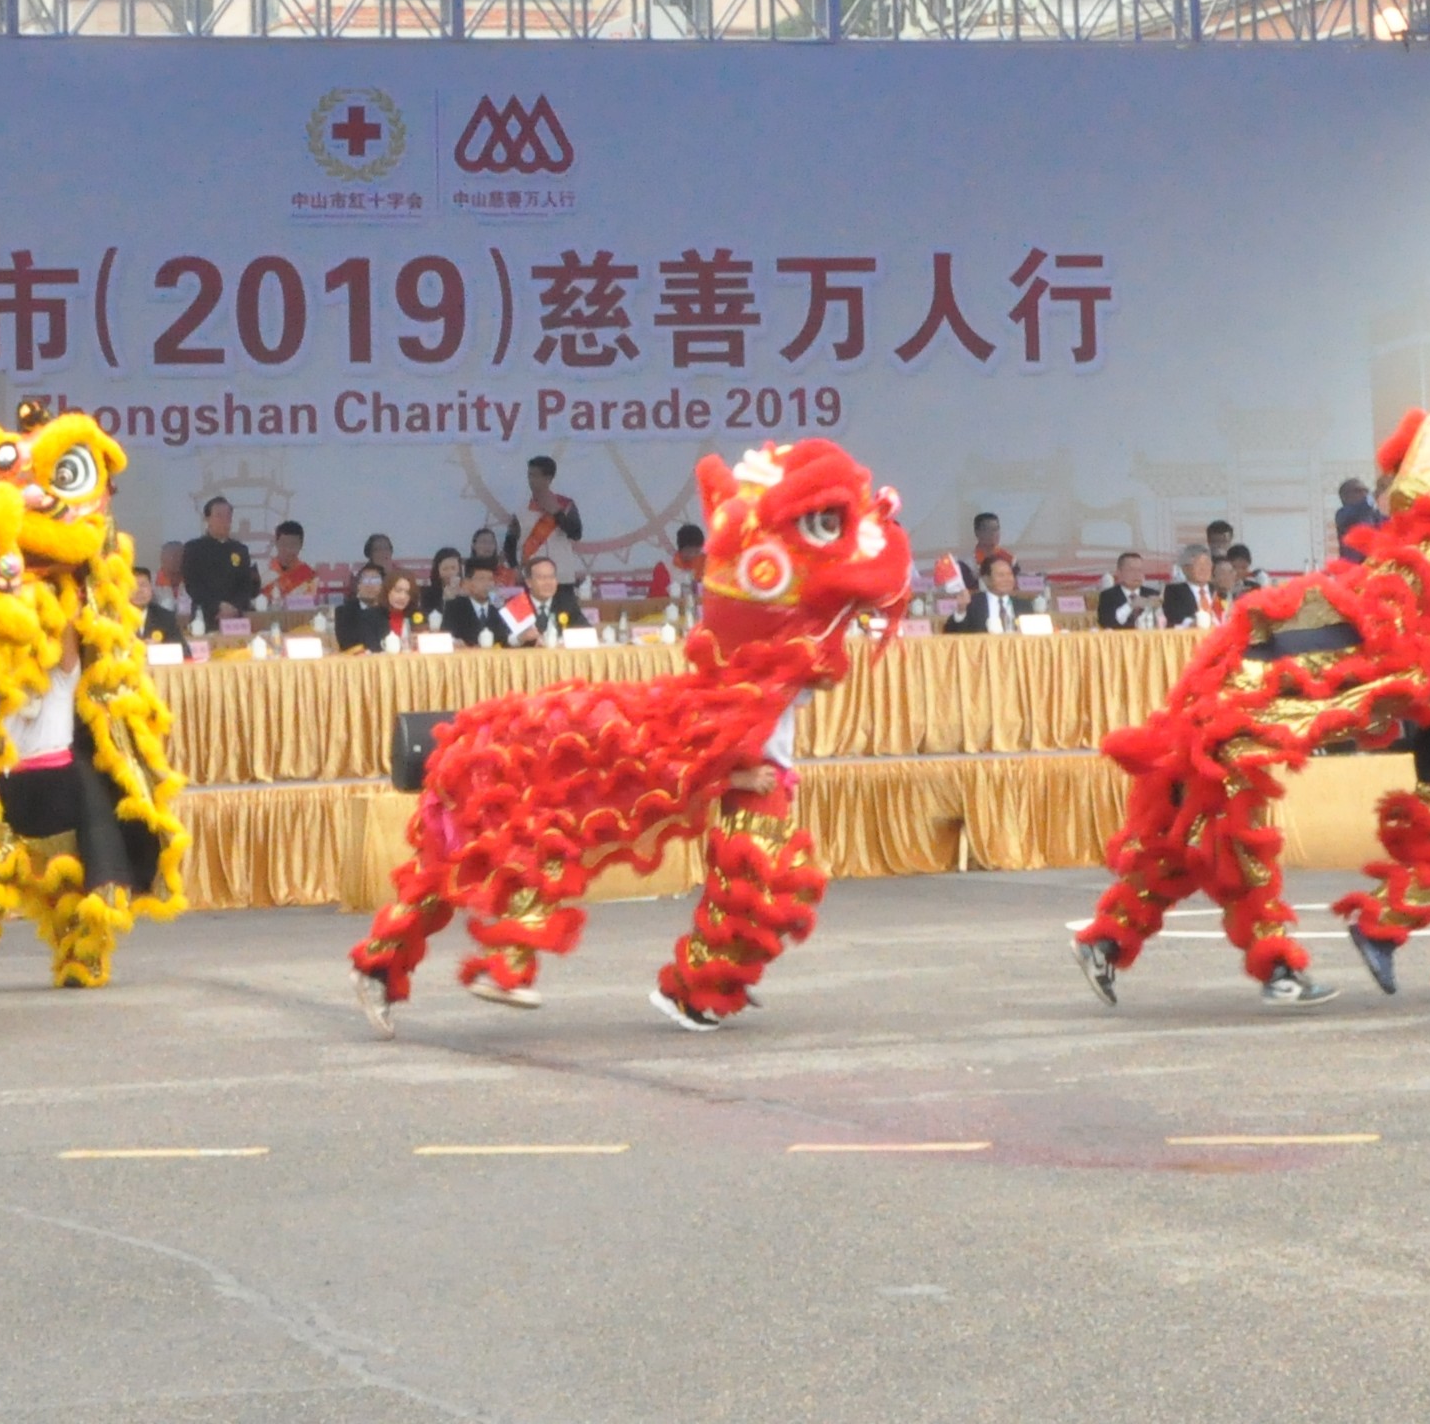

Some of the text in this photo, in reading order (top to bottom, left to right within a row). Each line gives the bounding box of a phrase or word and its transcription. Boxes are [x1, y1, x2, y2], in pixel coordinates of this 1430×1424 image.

[291, 191, 423, 210] 中山市红十字会
[452, 189, 577, 209] 中山慈善万人行
[333, 387, 522, 442] Charity
[536, 387, 711, 433] Parade
[724, 386, 842, 430] 2019
